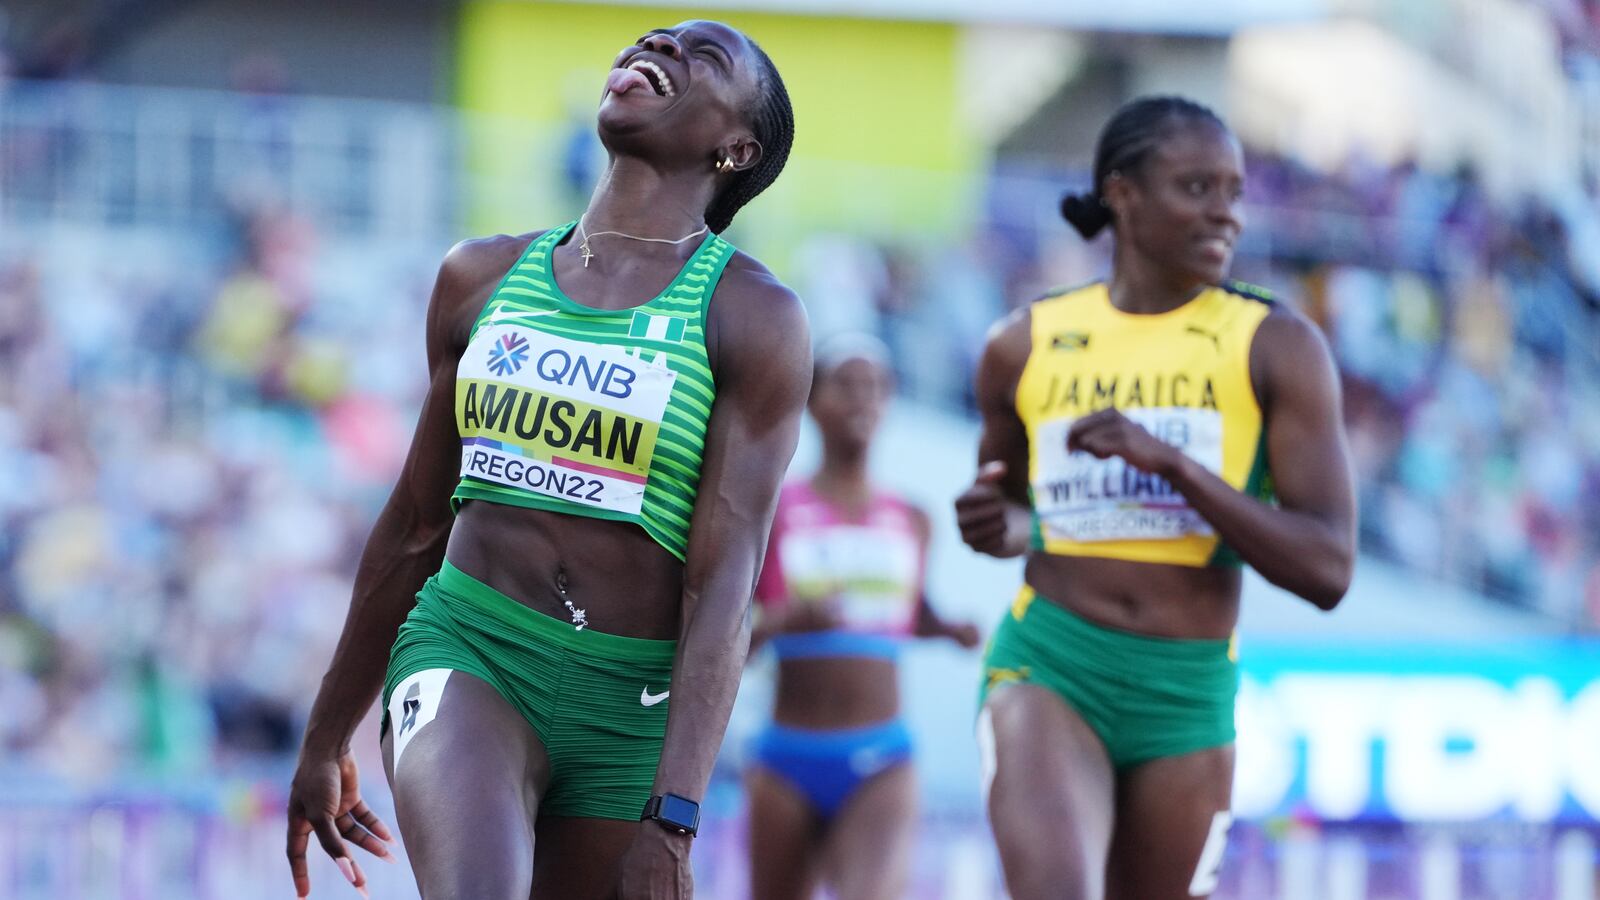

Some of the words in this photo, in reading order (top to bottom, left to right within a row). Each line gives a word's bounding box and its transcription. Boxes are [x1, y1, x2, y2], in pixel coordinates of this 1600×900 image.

[536, 349, 637, 399] QNB
[1040, 372, 1218, 413] JAMAICA
[464, 382, 643, 465] AMUSAN
